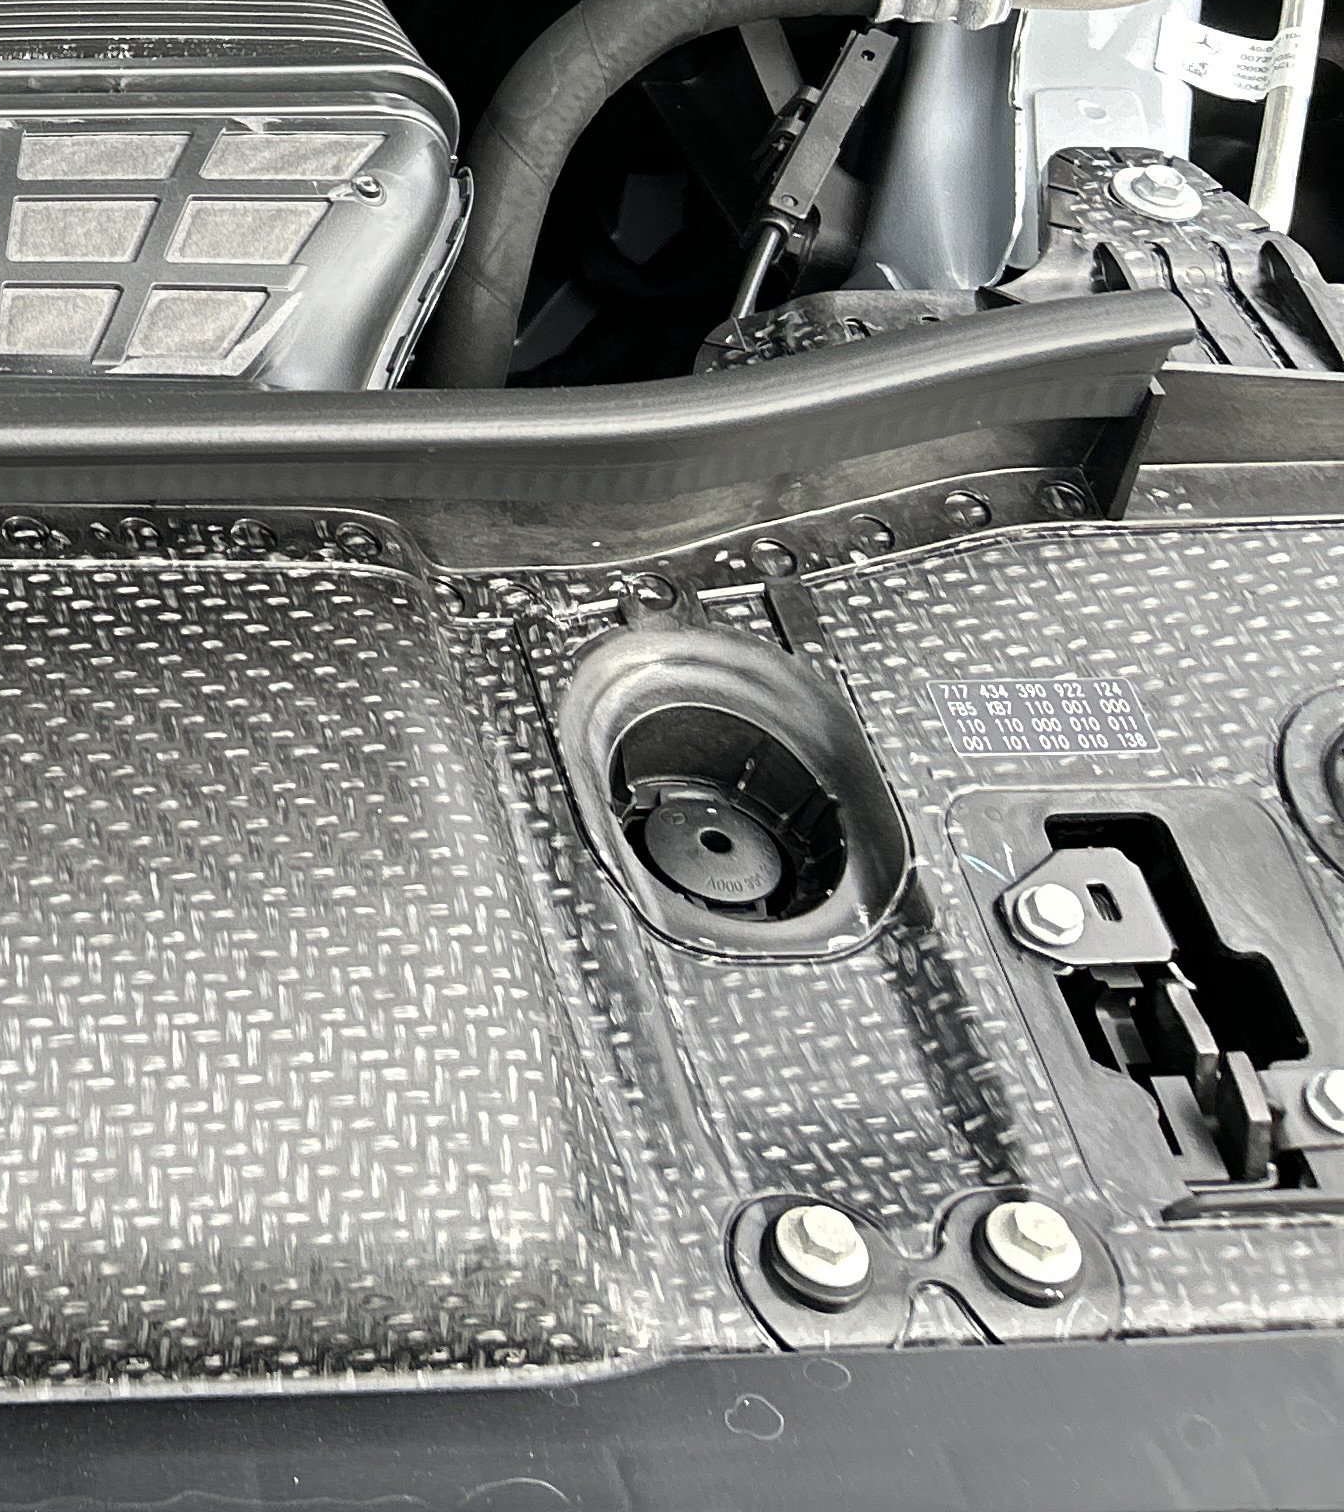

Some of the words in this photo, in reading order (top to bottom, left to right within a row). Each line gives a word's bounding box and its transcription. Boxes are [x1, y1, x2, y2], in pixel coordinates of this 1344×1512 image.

[939, 685, 967, 699] 717
[980, 685, 1008, 698] 434
[1016, 684, 1046, 698] 390
[1054, 683, 1084, 698] 922
[1094, 682, 1122, 697] 124
[947, 702, 977, 716] FB5
[986, 701, 1012, 715] KB7
[1025, 701, 1054, 715] 110
[1062, 700, 1091, 714] 001
[1100, 699, 1130, 713] 000
[957, 719, 985, 733] 110
[995, 718, 1023, 732] 110
[1032, 718, 1061, 732] 000
[1069, 717, 1100, 731] 010
[1108, 716, 1137, 730] 011
[962, 736, 992, 750] 001
[1002, 736, 1030, 750] 101
[1039, 735, 1069, 749] 010
[1078, 734, 1108, 748] 010
